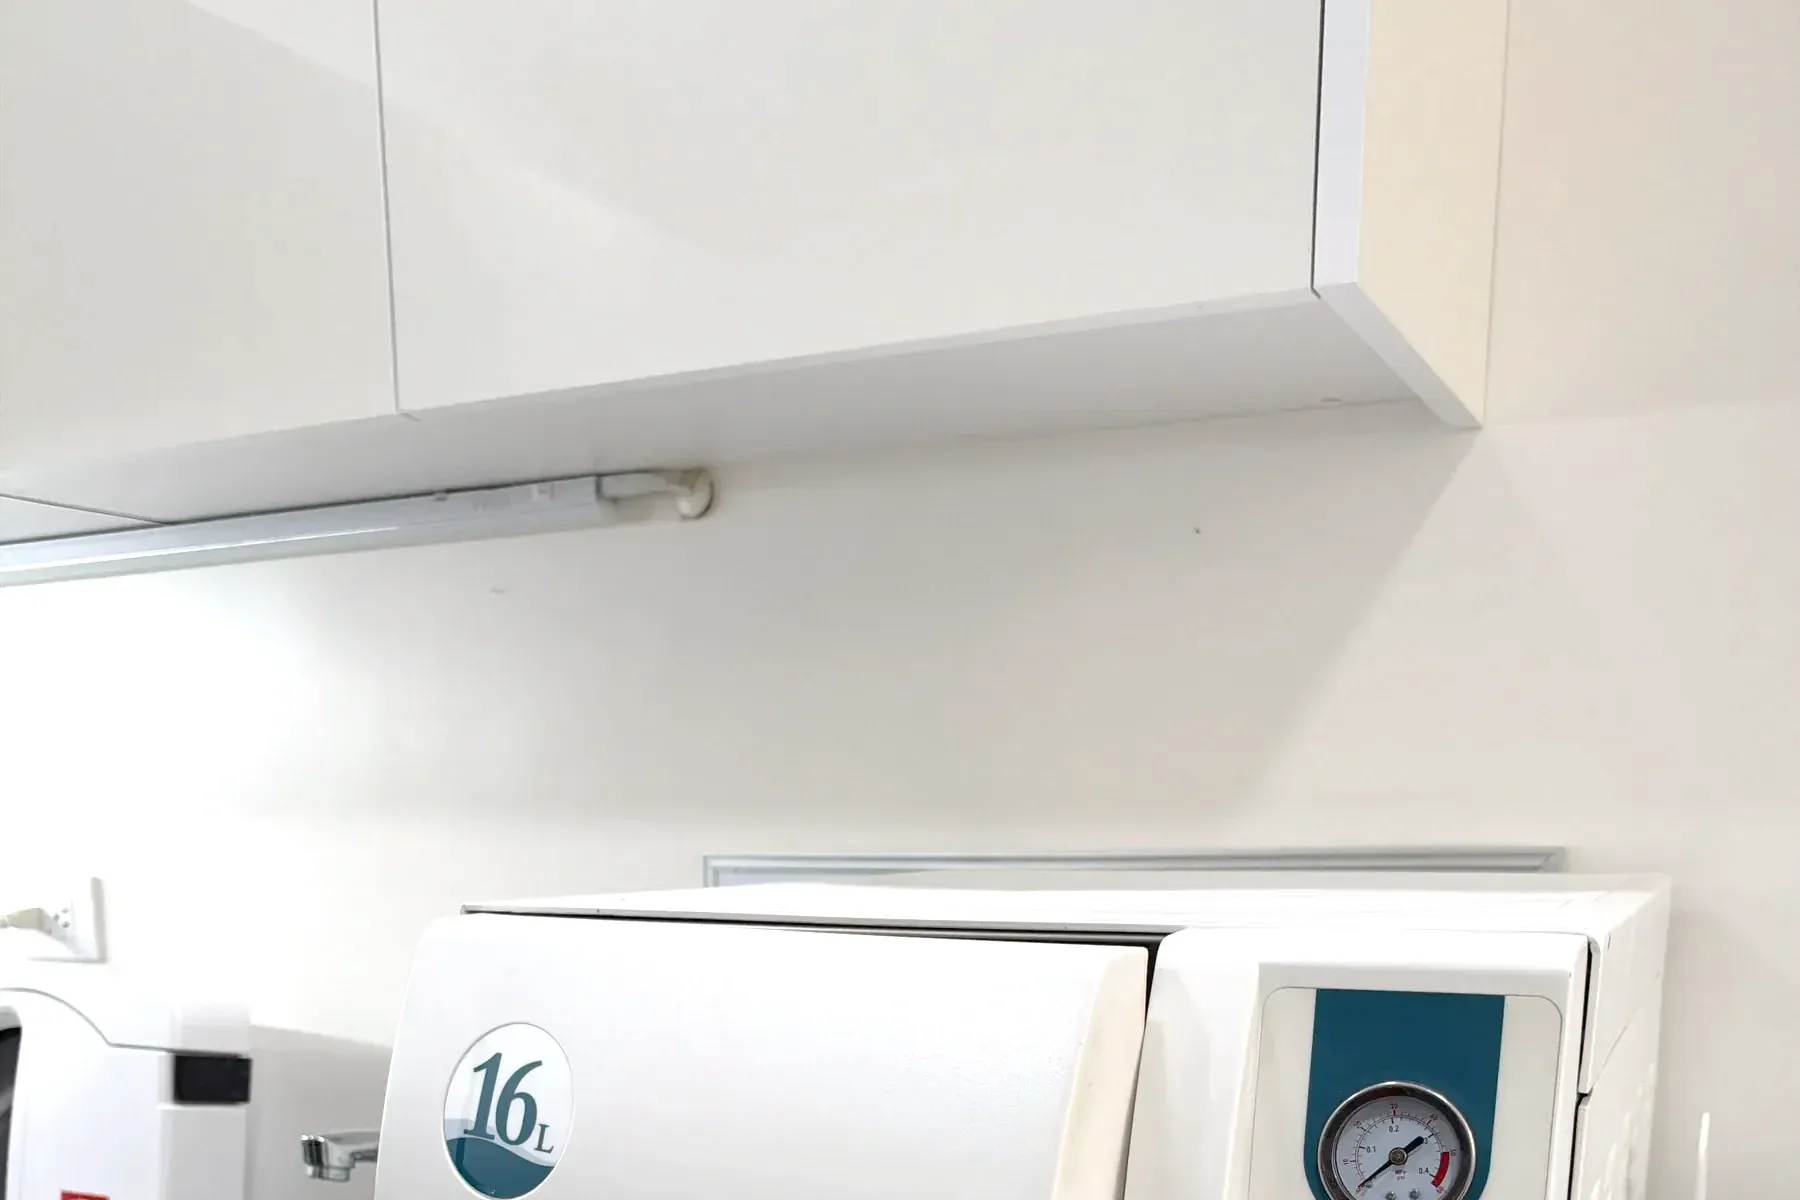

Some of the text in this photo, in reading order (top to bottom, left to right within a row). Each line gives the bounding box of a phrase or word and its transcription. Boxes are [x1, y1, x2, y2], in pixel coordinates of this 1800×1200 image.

[1388, 1125, 1400, 1133] 0.2
[1366, 1145, 1376, 1153] 0.1
[1418, 1167, 1429, 1175] 0.4
